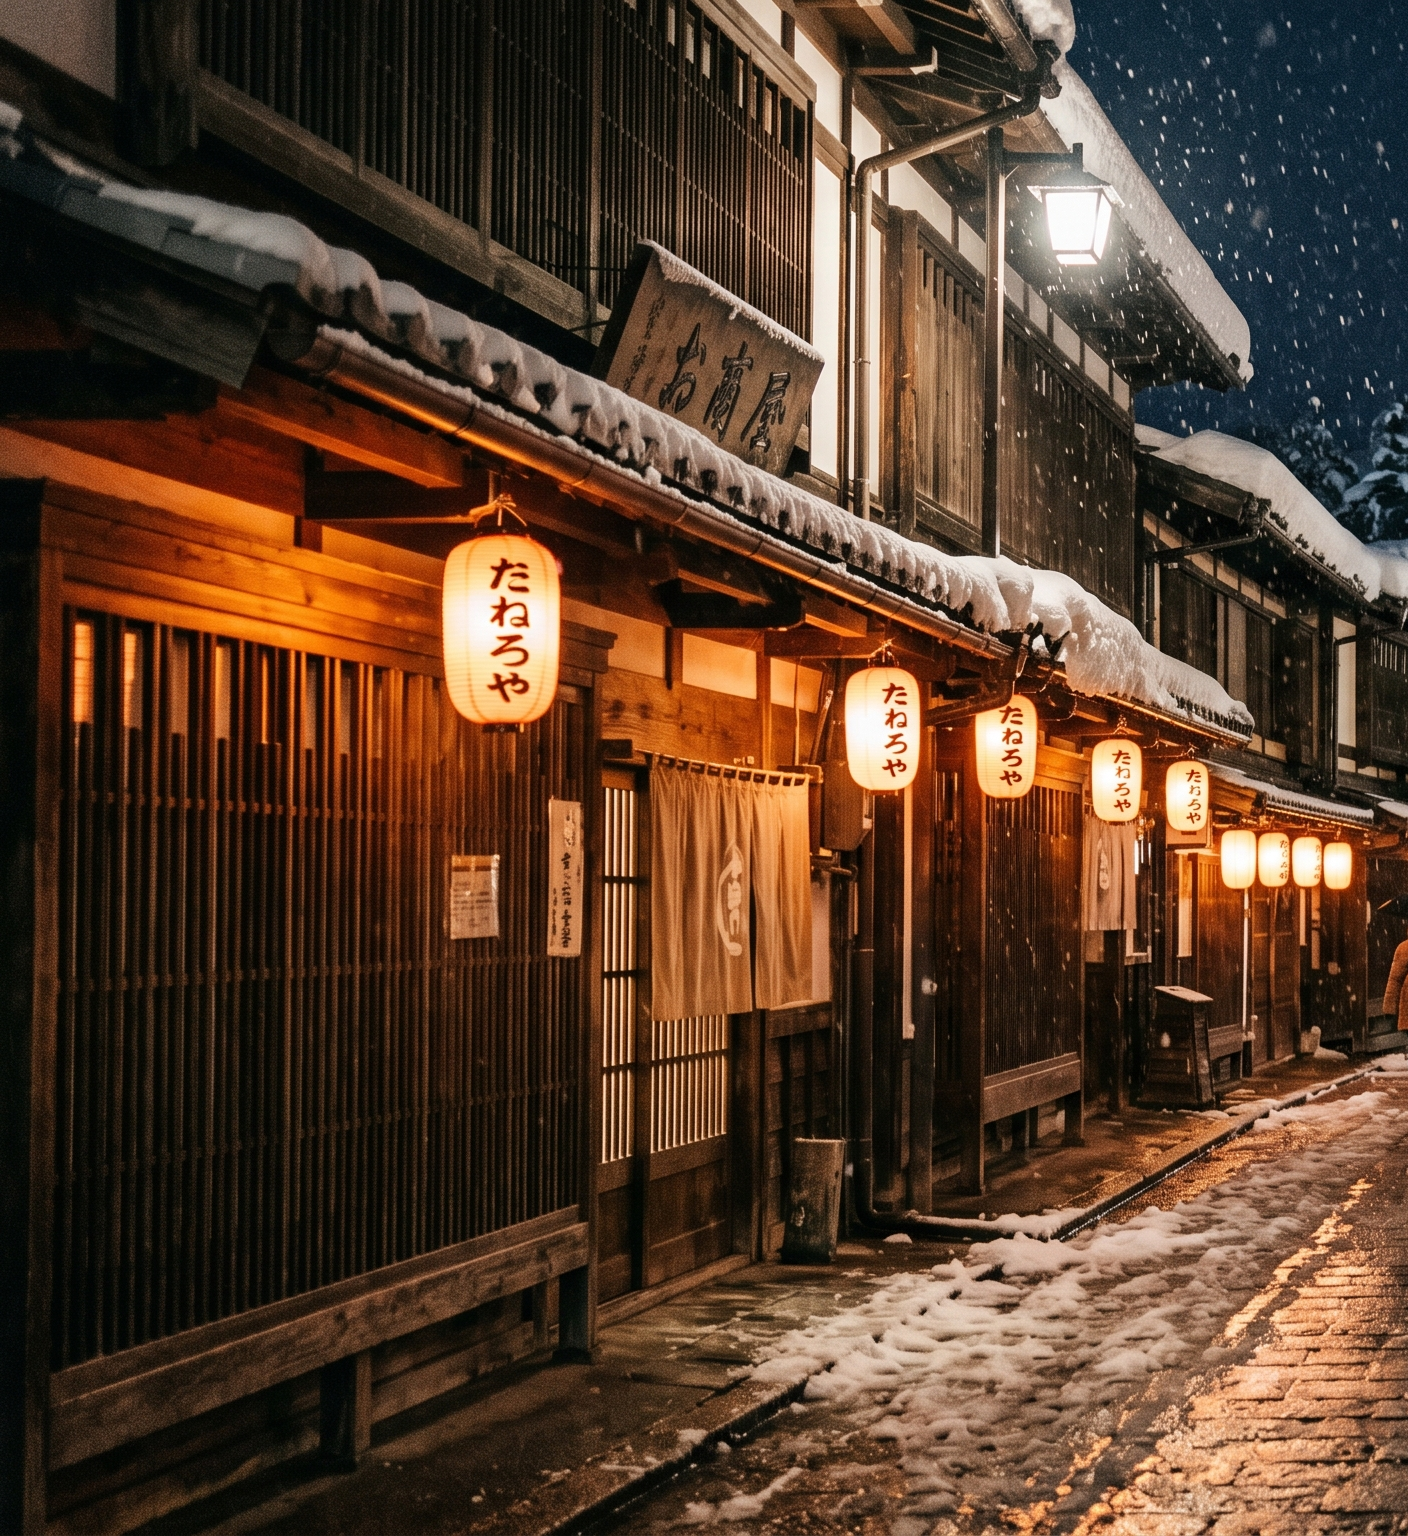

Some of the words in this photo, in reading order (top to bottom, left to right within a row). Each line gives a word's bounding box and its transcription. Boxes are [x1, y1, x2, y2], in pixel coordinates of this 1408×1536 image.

[487, 557, 530, 703] たねろや
[882, 682, 908, 777] たねろや
[999, 705, 1024, 786] たねろや
